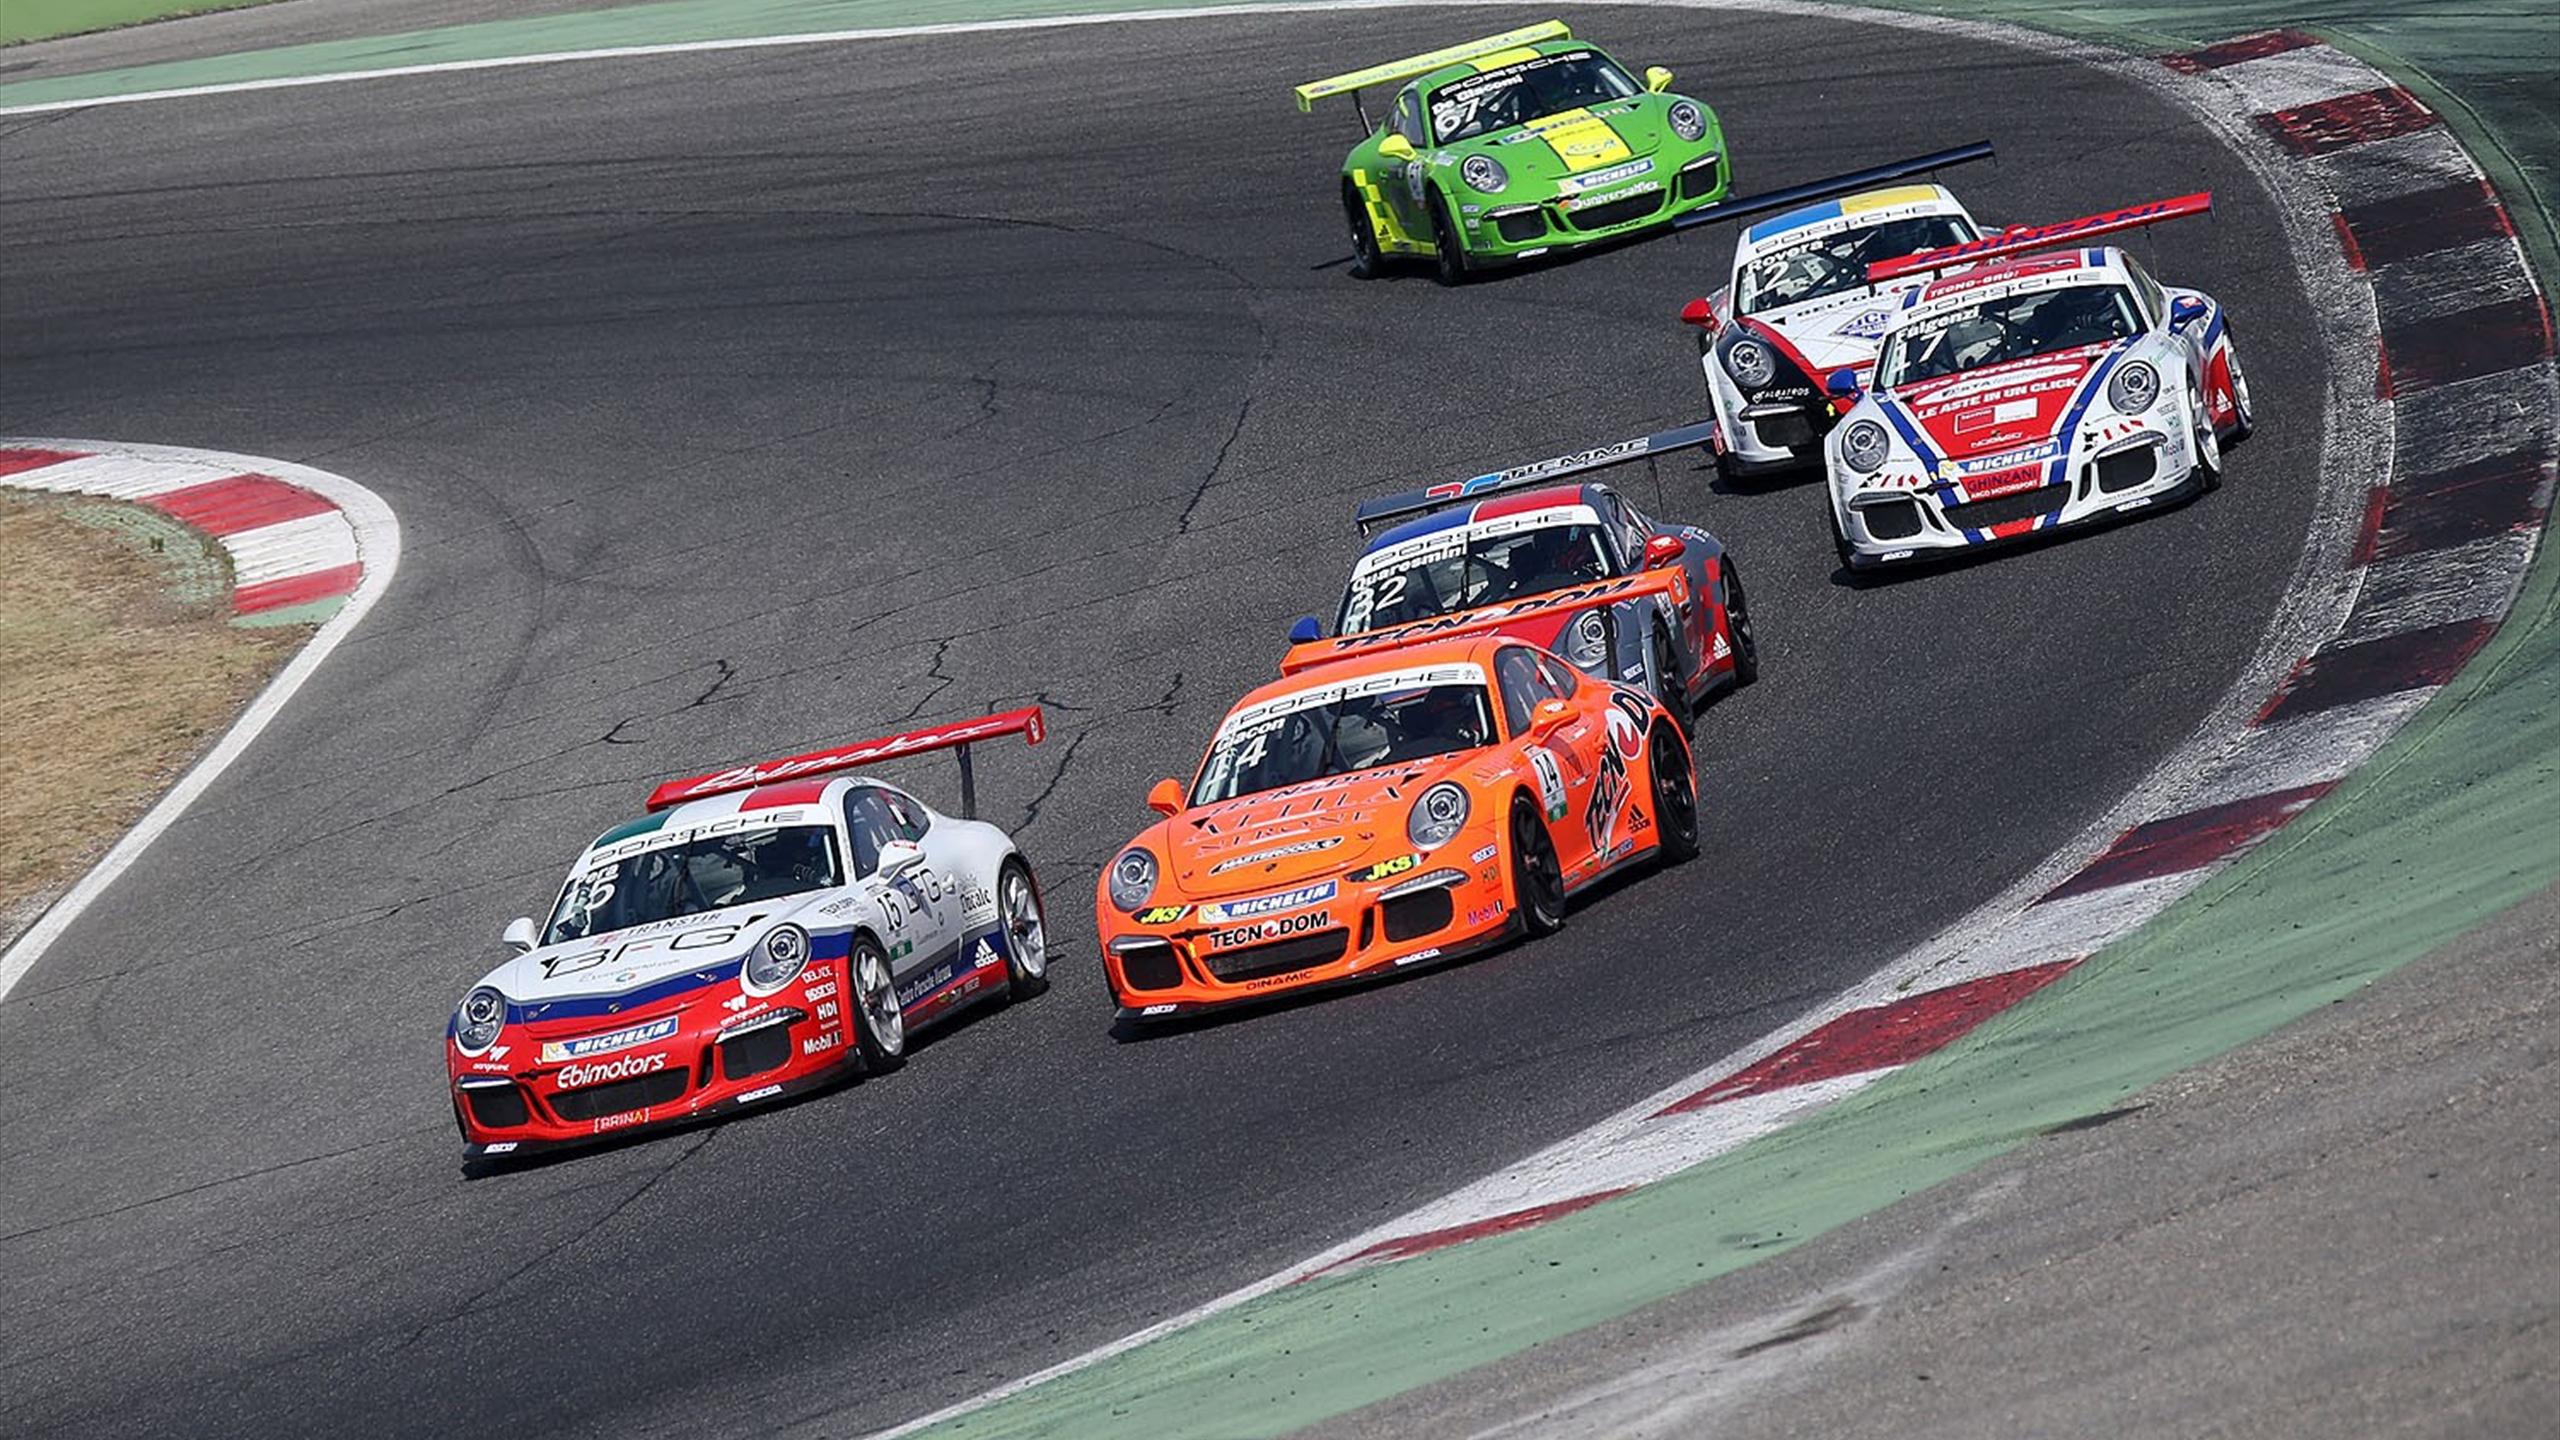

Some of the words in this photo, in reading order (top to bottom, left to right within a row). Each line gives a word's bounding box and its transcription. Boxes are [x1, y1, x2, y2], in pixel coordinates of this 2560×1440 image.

[1440, 52, 1592, 97] PORSCHE
[1431, 98, 1455, 116] De
[1434, 97, 1481, 134] 67
[1582, 160, 1650, 188] MICHELIN
[1582, 179, 1660, 207] universalflex
[1756, 204, 1938, 253] PORSCHE
[1907, 271, 2101, 321] PORSCHE
[1918, 405, 1937, 420] LE
[1939, 396, 1981, 415] ASTE
[1984, 391, 2001, 403] IN
[2004, 384, 2029, 398] UN
[2030, 377, 2080, 394] CLICK
[1967, 444, 2054, 473] MICHELIN
[1967, 466, 2038, 491] GHINZANI
[1372, 511, 1574, 567] PORSCHE
[1334, 577, 1638, 651] TECNODOM
[1240, 669, 1460, 725] PORSCHE
[1534, 753, 1561, 794] 14
[590, 810, 805, 866] PORSCHE
[1365, 856, 1412, 882] JKS
[876, 892, 902, 932] 15
[1140, 905, 1181, 923] JKS
[1230, 883, 1330, 917] MICHELIN
[1209, 910, 1329, 949] TECNODOM
[541, 924, 742, 981] BFG
[1246, 969, 1314, 991] DINAMIC
[816, 1000, 838, 1021] HDI
[574, 1020, 673, 1054] MICHELIN
[803, 1034, 832, 1056] Mobil
[557, 1053, 669, 1089] Ebimotors
